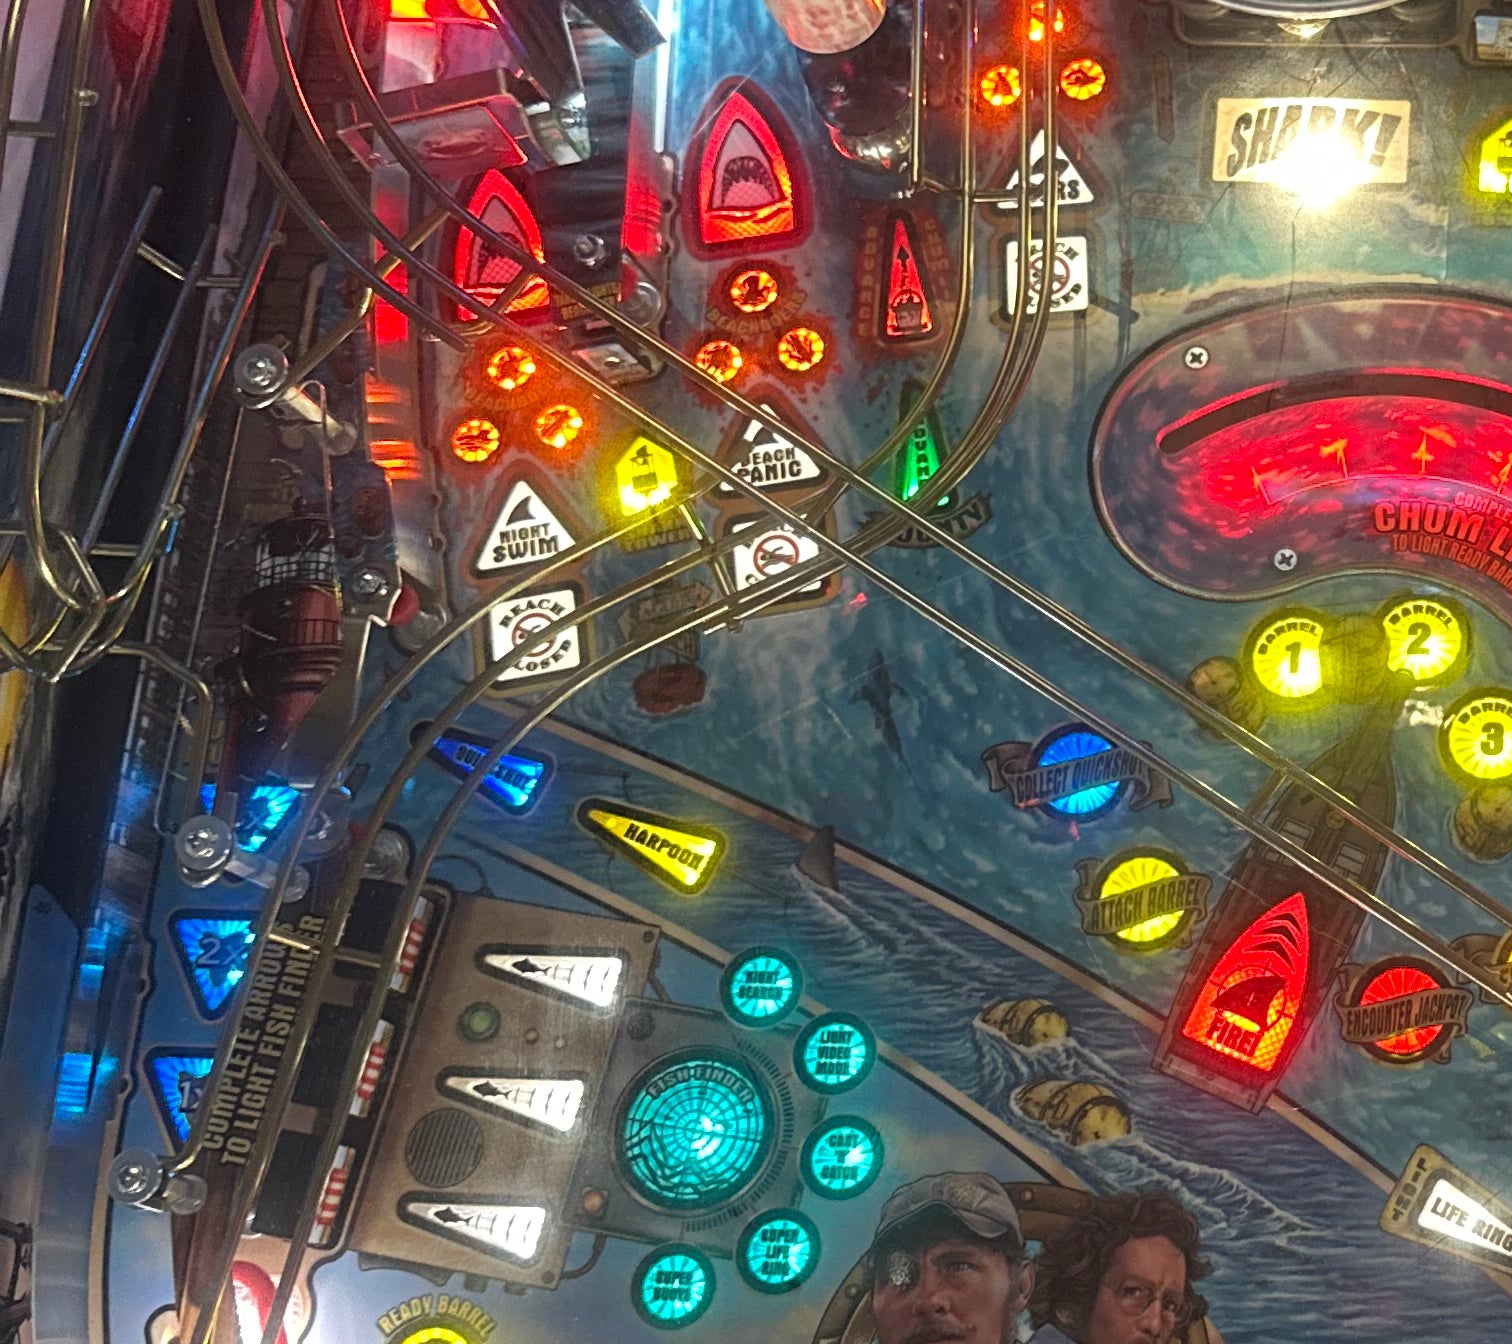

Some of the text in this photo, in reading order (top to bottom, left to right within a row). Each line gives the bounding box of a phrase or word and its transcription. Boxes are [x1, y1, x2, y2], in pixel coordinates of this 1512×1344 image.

[738, 461, 803, 485] PANIC
[499, 522, 551, 544] NIGHT
[1373, 501, 1485, 544] CHUM
[493, 535, 560, 564] SWIM
[1392, 534, 1408, 551] TO
[1411, 534, 1449, 555] LIGHT
[1448, 542, 1490, 570] READY
[501, 598, 566, 629] BEACH
[1388, 602, 1455, 630] BARREL
[1257, 621, 1319, 655] BARREL
[1406, 622, 1432, 655] 2
[513, 638, 573, 673] LOSED
[1284, 641, 1302, 674] 1
[1480, 722, 1505, 755] 3
[1016, 765, 1070, 801] COLLECT
[624, 823, 705, 871] HARPOON
[1090, 877, 1203, 929] ATTACH BARREL
[258, 1003, 298, 1057] FISH
[1346, 993, 1468, 1036] ENCOUNTER JACKPOT
[819, 1031, 854, 1044] LIGHT
[1208, 1016, 1266, 1055] FIRE!
[203, 1027, 260, 1152] COMPLETE
[223, 1059, 277, 1130] LIGHT
[647, 1066, 754, 1103] FISH FINDER
[221, 1135, 251, 1166] TO
[829, 1133, 860, 1147] CAST
[821, 1165, 858, 1180] CATCH
[1392, 1157, 1427, 1222] LIGHT
[1430, 1196, 1470, 1227] LIFE
[760, 1228, 799, 1242] SUPER
[765, 1244, 792, 1259] LIFE
[655, 1269, 694, 1284] SUPER
[761, 1261, 791, 1276] RING
[377, 1294, 498, 1339] READY BARREL
